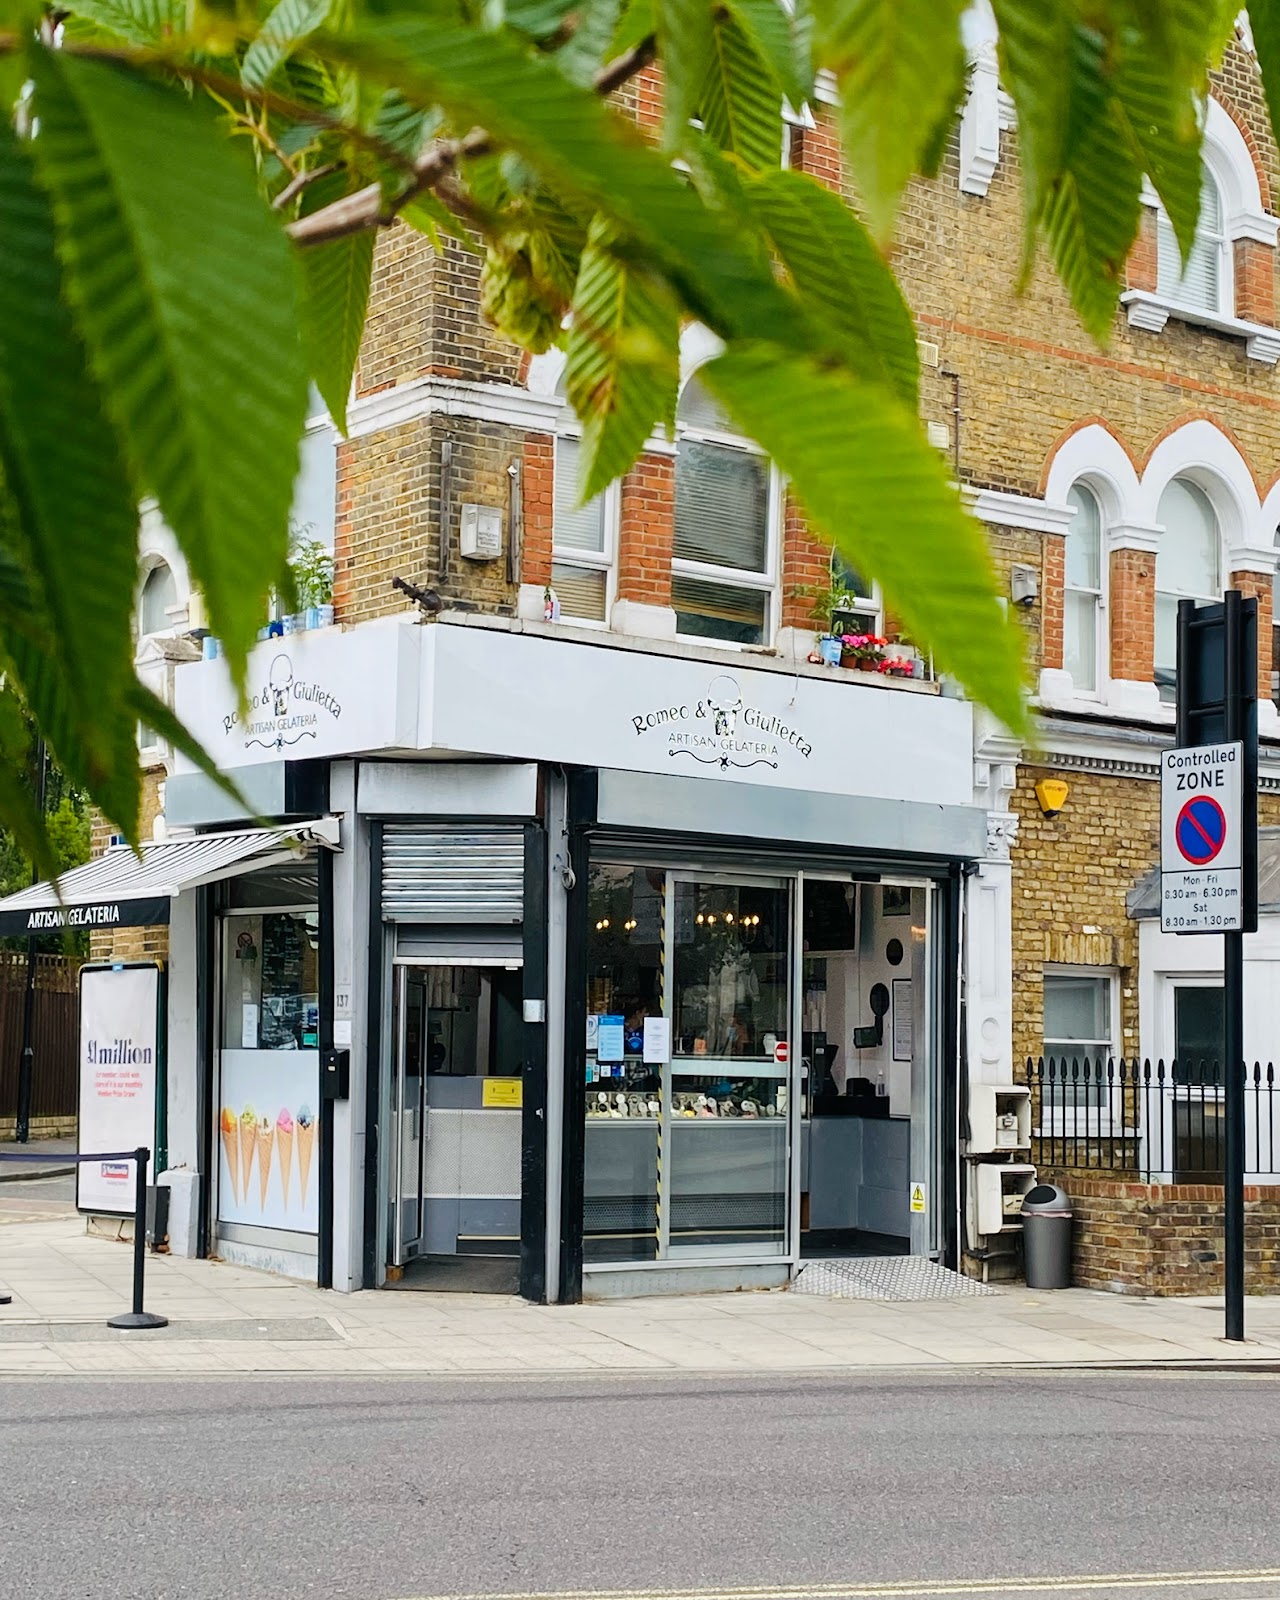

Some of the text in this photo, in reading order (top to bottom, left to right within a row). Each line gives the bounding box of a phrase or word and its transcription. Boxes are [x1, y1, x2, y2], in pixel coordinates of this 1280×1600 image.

[262, 687, 270, 705] &
[293, 681, 342, 720] Giulietta
[245, 714, 317, 735] ARTISAN GELATERIA
[631, 701, 812, 759] Romeo & Giulietta
[668, 733, 778, 756] ARTISAN GELATERIA
[1167, 747, 1236, 769] Controlled
[1176, 769, 1225, 791] ZONE
[1183, 876, 1201, 885] Mon
[1207, 875, 1218, 884] Fri
[1203, 887, 1223, 898] 6.30
[1225, 888, 1238, 898] pm
[27, 905, 120, 929] ARTISAN GELATERIA
[1193, 903, 1208, 913] Sat
[1165, 917, 1184, 927] 8.30
[1204, 915, 1222, 926] 1.30
[1224, 917, 1236, 926] pm
[336, 994, 349, 1008] 137
